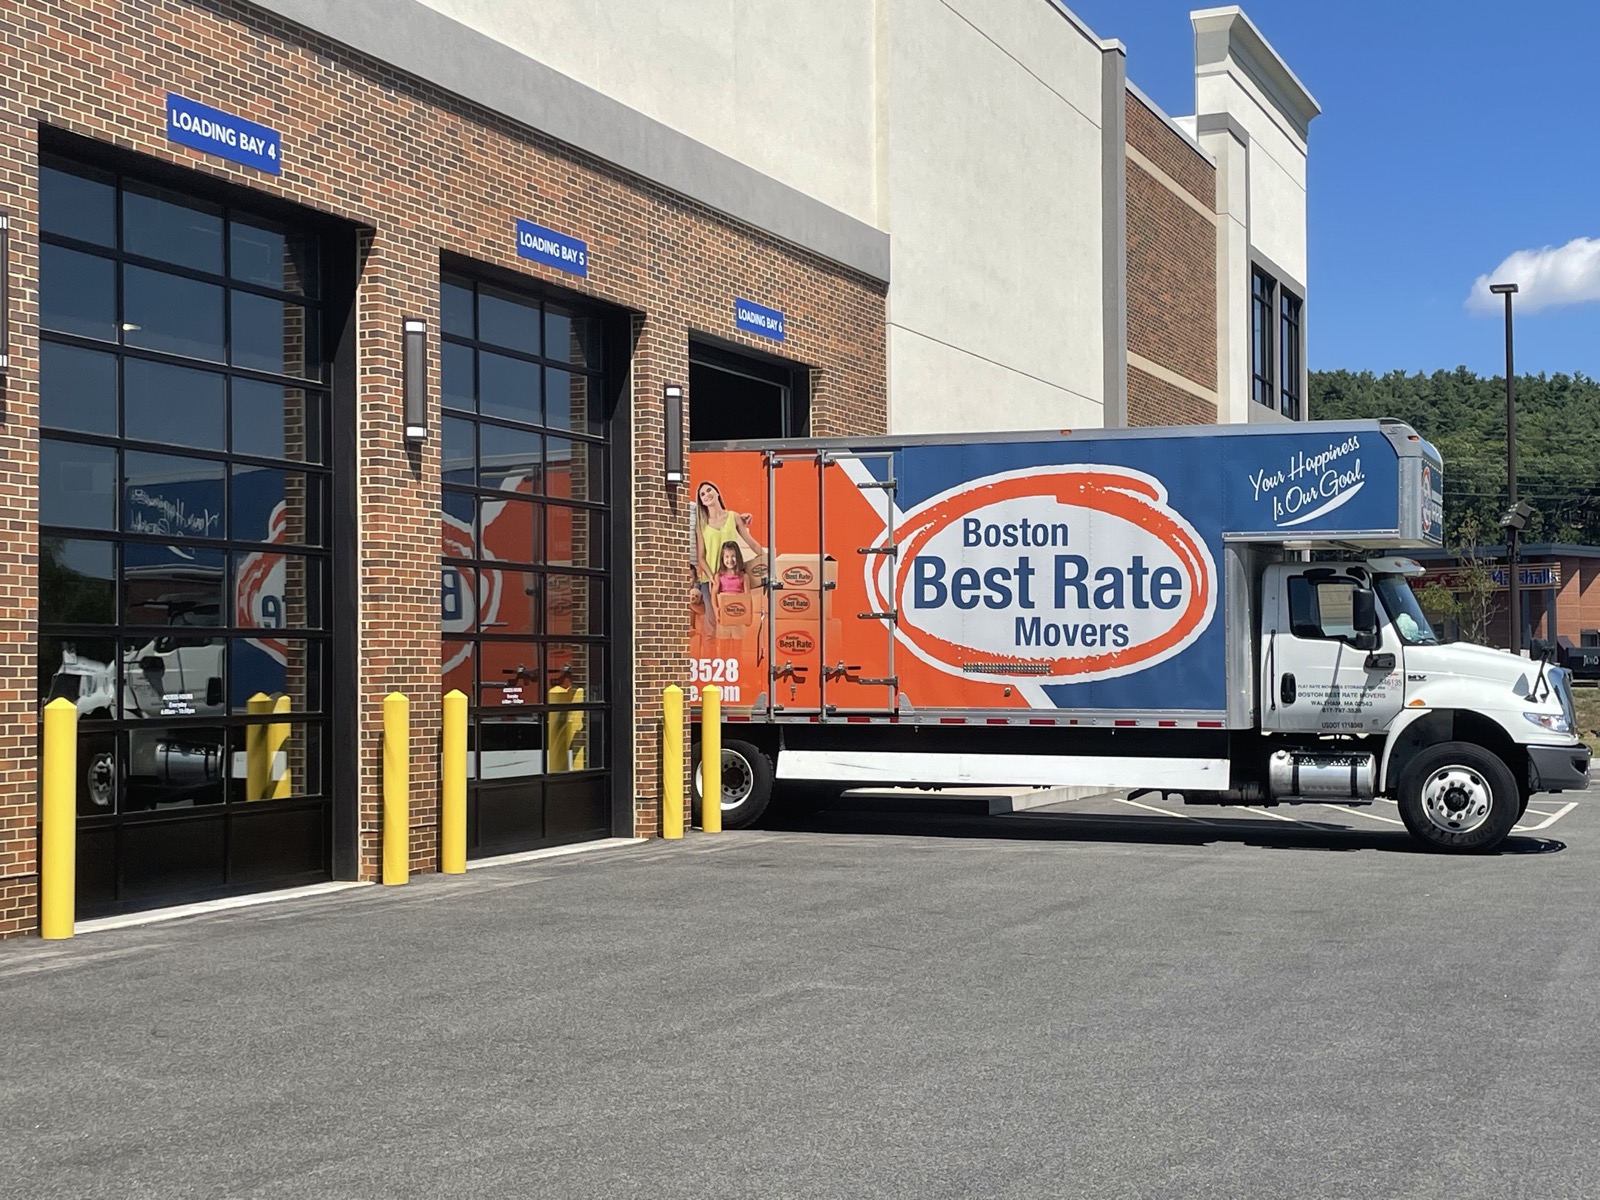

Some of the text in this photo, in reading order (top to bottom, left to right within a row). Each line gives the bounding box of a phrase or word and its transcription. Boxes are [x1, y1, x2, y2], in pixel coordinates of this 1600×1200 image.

[172, 109, 277, 160] LOADING BAY 4
[520, 231, 585, 266] LOADING BAY 5
[738, 307, 783, 333] LOADING BAY 6
[1249, 435, 1360, 501] Your Happiness
[1273, 458, 1366, 521] Is Our Goal.
[963, 518, 1069, 548] Boston
[913, 554, 1183, 610] Best Rate
[779, 640, 813, 648] Best Rate
[1014, 616, 1130, 647] Movers
